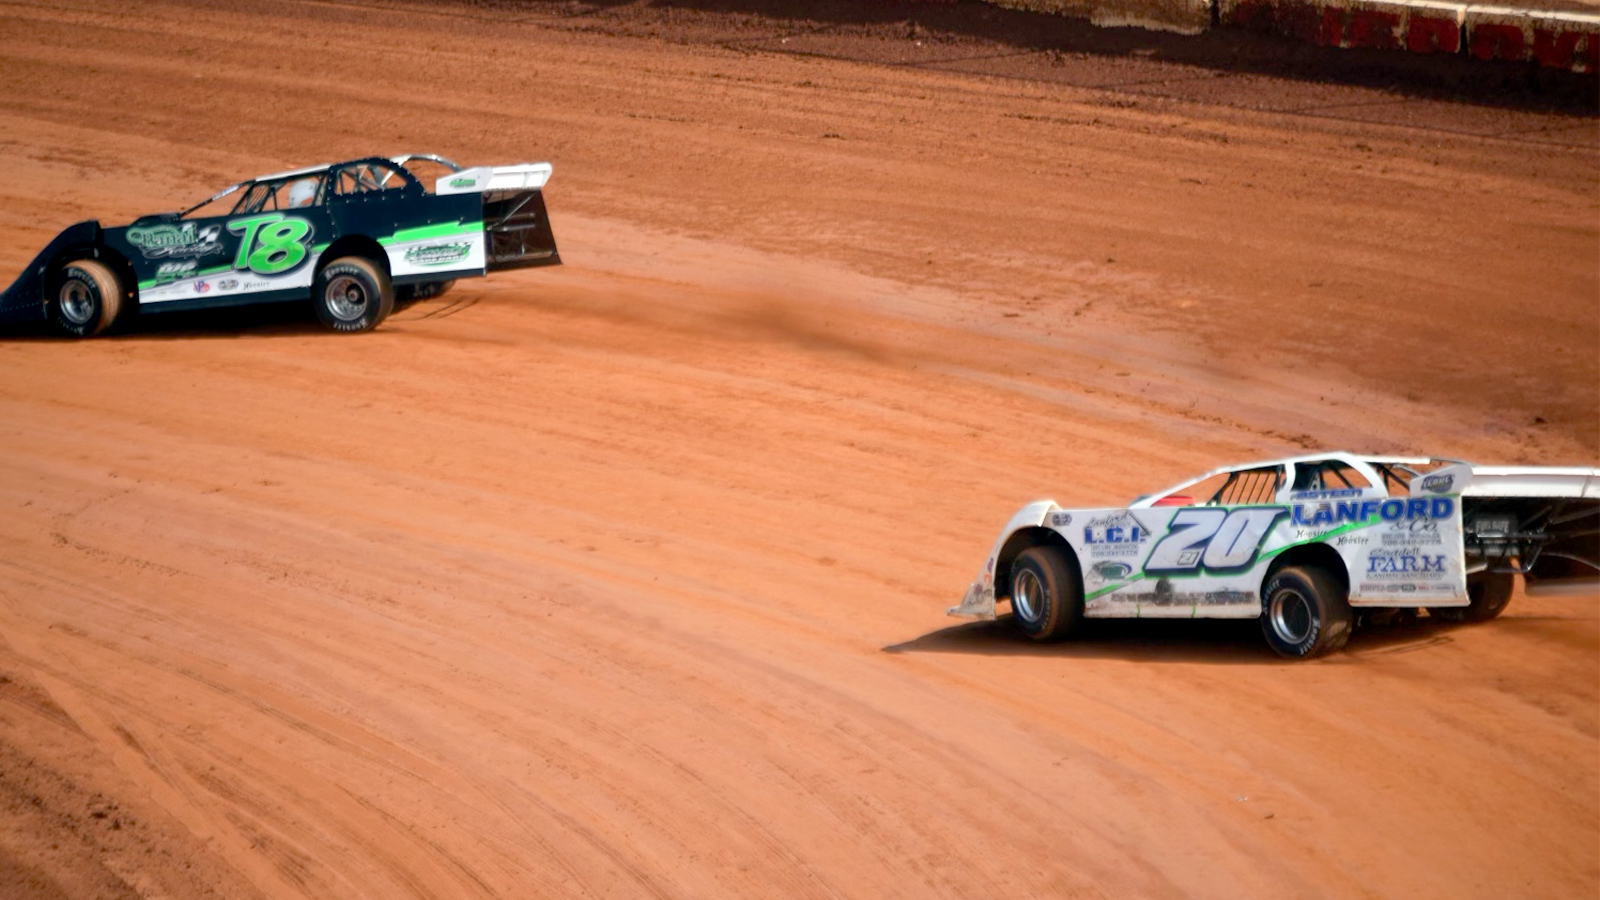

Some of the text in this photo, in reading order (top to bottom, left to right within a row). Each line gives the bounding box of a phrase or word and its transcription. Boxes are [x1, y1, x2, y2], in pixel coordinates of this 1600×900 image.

[227, 213, 314, 277] T8
[1290, 498, 1455, 527] LANFORD
[1142, 506, 1289, 577] 20
[1336, 536, 1369, 547] Hoosier
[1367, 555, 1446, 573] FARM
